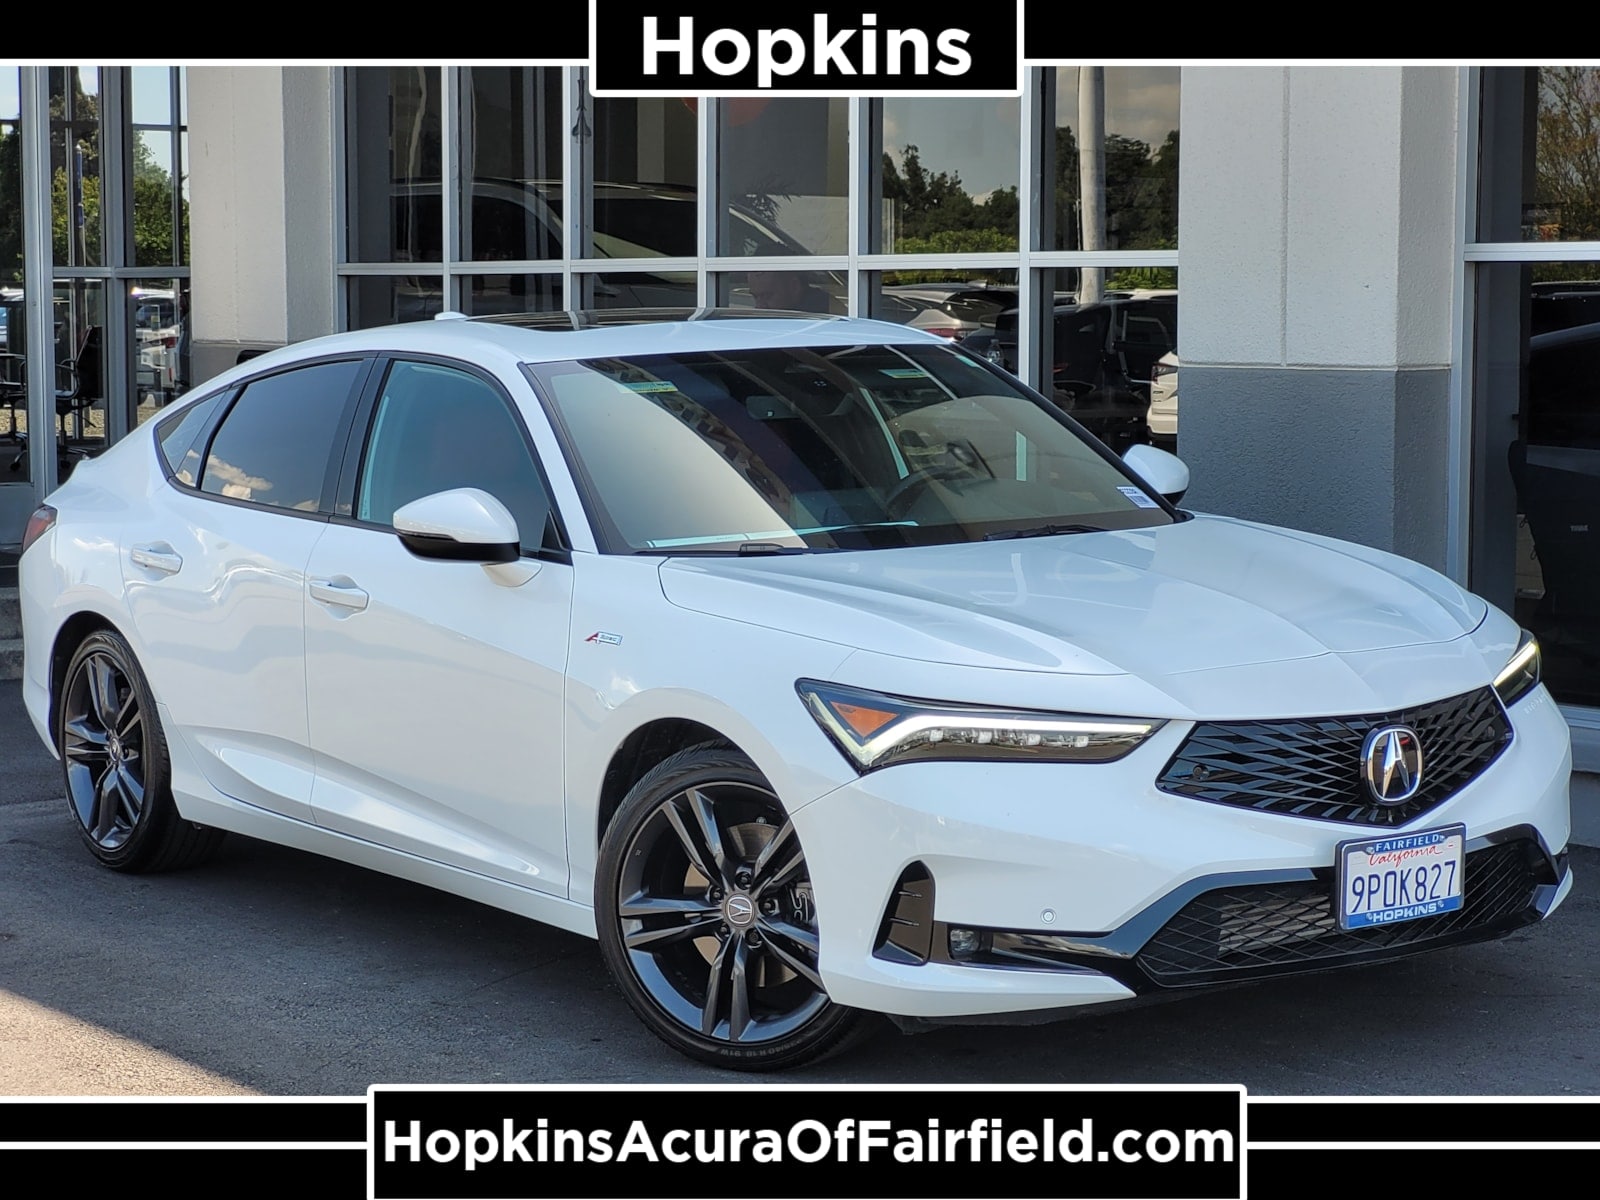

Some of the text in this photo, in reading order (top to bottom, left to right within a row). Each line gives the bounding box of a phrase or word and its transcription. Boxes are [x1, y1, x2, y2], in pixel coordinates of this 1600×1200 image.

[1375, 834, 1439, 852] FAIRFIELD
[1368, 845, 1443, 867] California
[1372, 902, 1437, 923] HOPKINS
